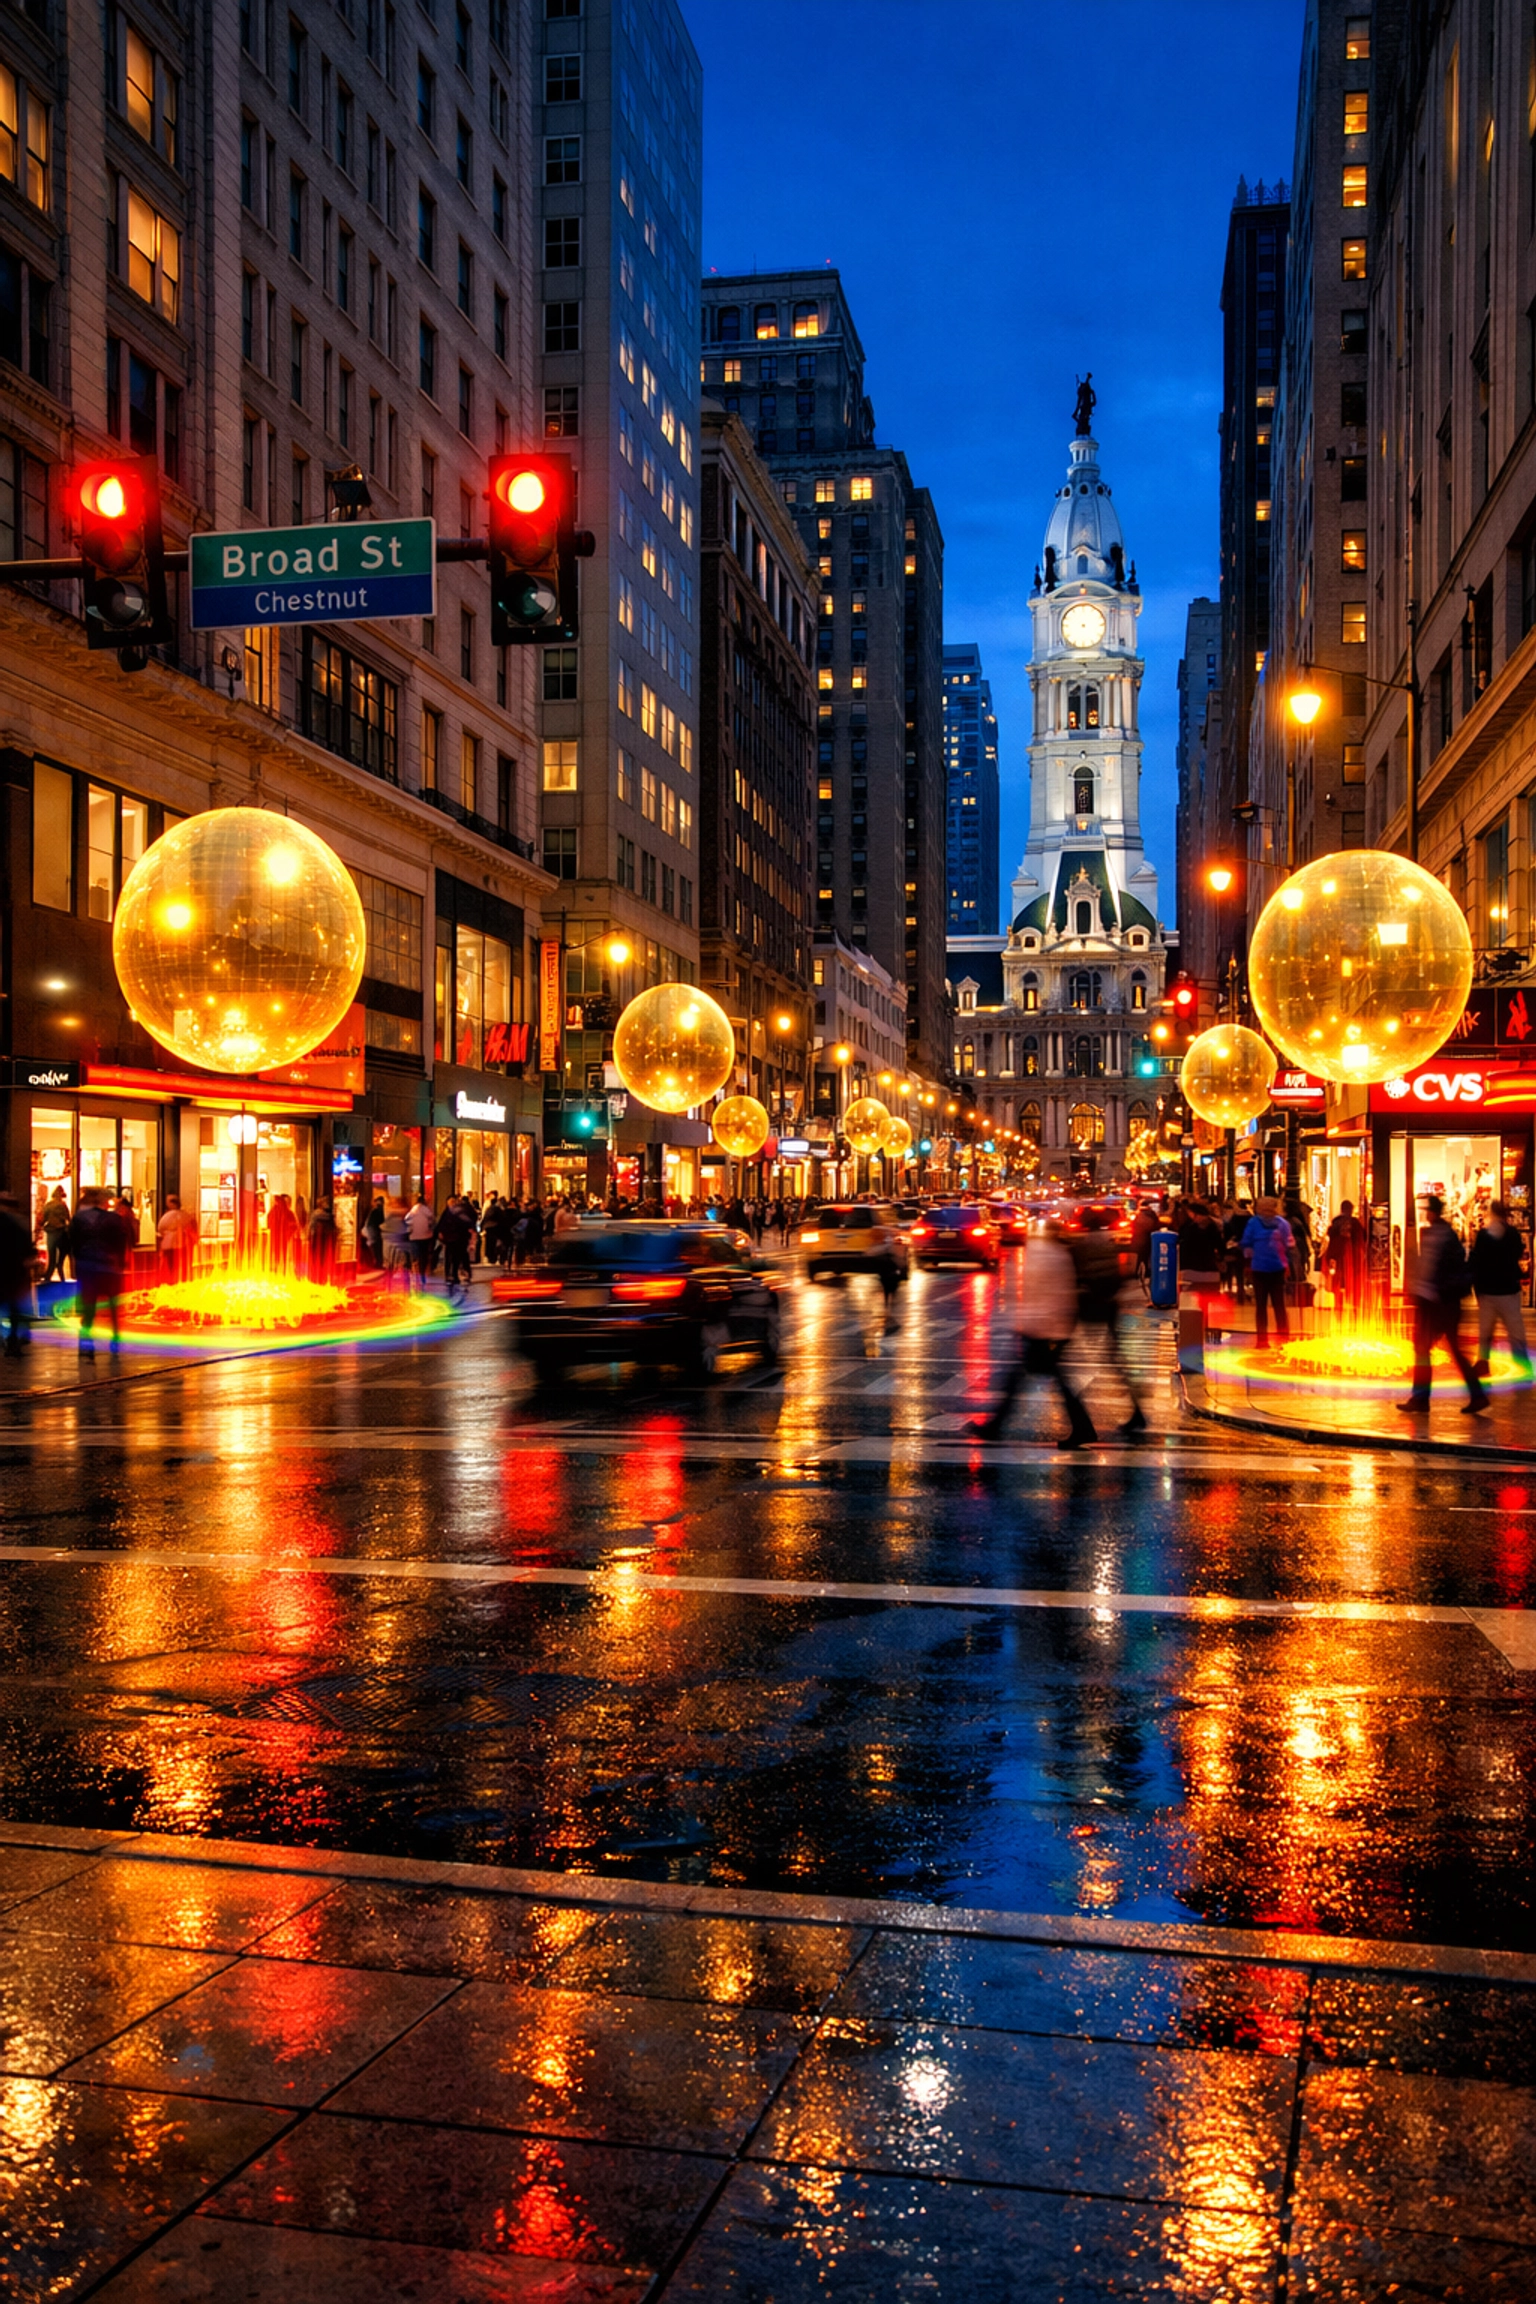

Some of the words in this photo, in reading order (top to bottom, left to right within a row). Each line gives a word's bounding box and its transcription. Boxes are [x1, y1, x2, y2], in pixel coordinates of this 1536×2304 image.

[223, 538, 338, 579] Broad
[360, 536, 403, 569] St
[255, 587, 368, 613] Chestnut
[1413, 1072, 1483, 1102] CVS
